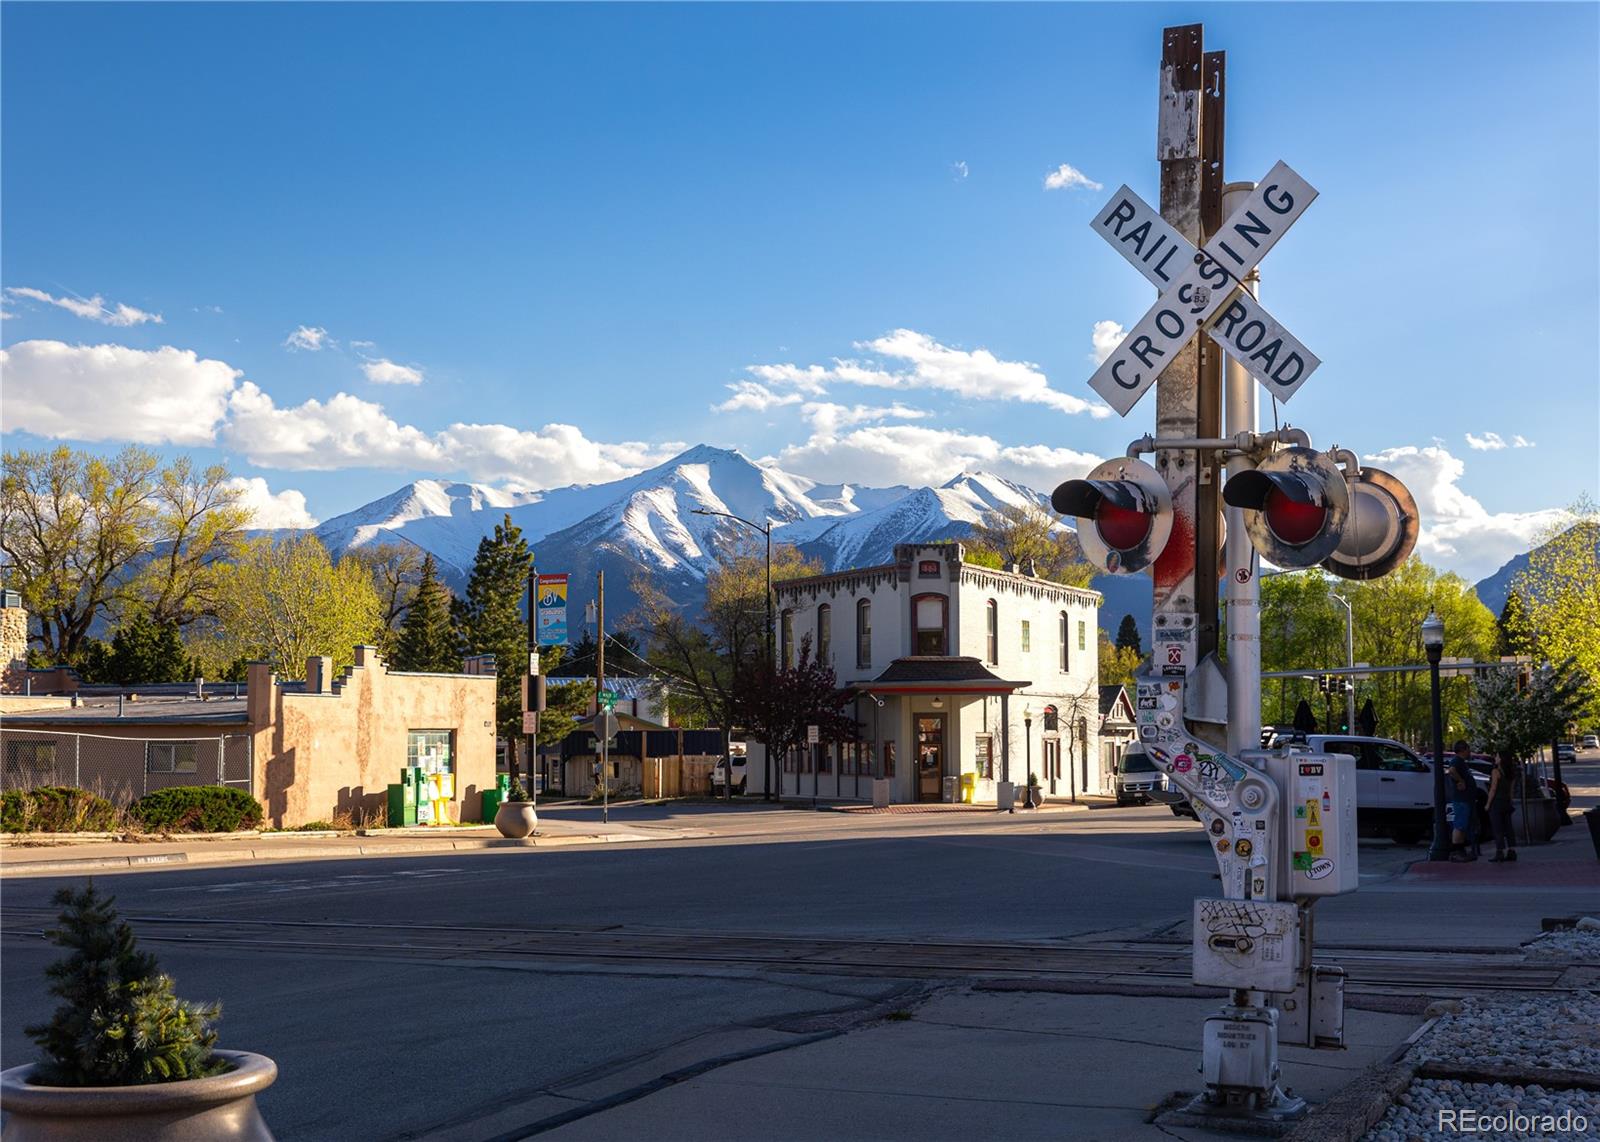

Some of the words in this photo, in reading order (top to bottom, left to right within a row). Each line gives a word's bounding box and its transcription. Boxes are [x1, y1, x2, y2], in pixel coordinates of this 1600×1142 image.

[1103, 199, 1179, 282] RAIL
[1214, 300, 1304, 386] ROAD
[1111, 185, 1294, 390] CROSSING
